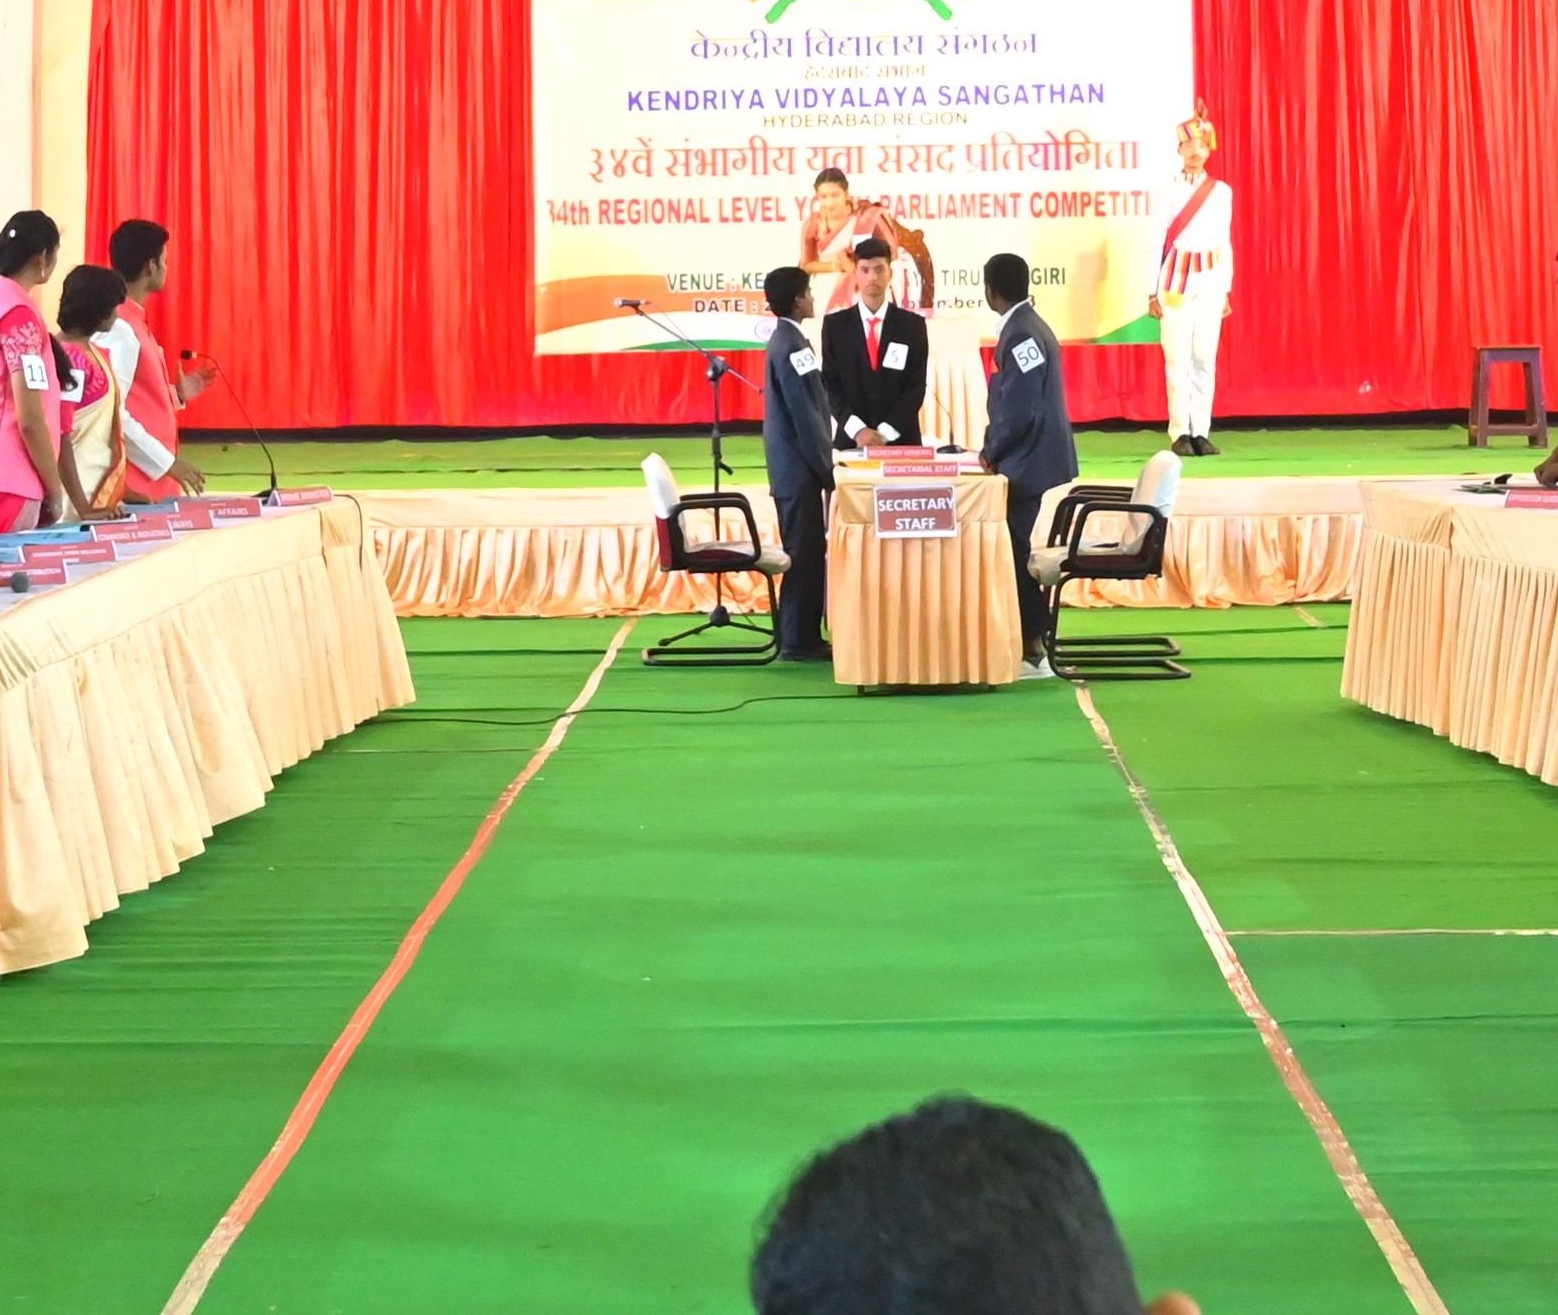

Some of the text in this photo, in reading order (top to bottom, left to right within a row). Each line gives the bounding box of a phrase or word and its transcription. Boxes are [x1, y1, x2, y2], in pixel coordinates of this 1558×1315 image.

[690, 28, 794, 62] केन्द्रीय
[804, 28, 924, 59] विद्यालय
[628, 83, 1105, 112] KENDRIYA VIDYALAYA SANGATHAN
[763, 111, 969, 128] HYDERABAD REGION
[664, 136, 796, 178] संभागीय
[876, 135, 955, 173] संसद
[965, 129, 1141, 173] प्रतियोगिता
[598, 196, 710, 225] REGIONAL
[718, 196, 787, 222] LEVEL
[880, 193, 1021, 220] PARLIAMENT
[667, 273, 725, 291] VENUE
[941, 267, 1066, 286] TIRUGIRI
[694, 300, 745, 313] DATE
[796, 352, 815, 370] 49
[890, 350, 899, 364] 5
[1016, 345, 1040, 367] 50
[26, 364, 46, 383] 11
[878, 497, 954, 512] SECRETARY
[895, 517, 936, 530] STAFF
